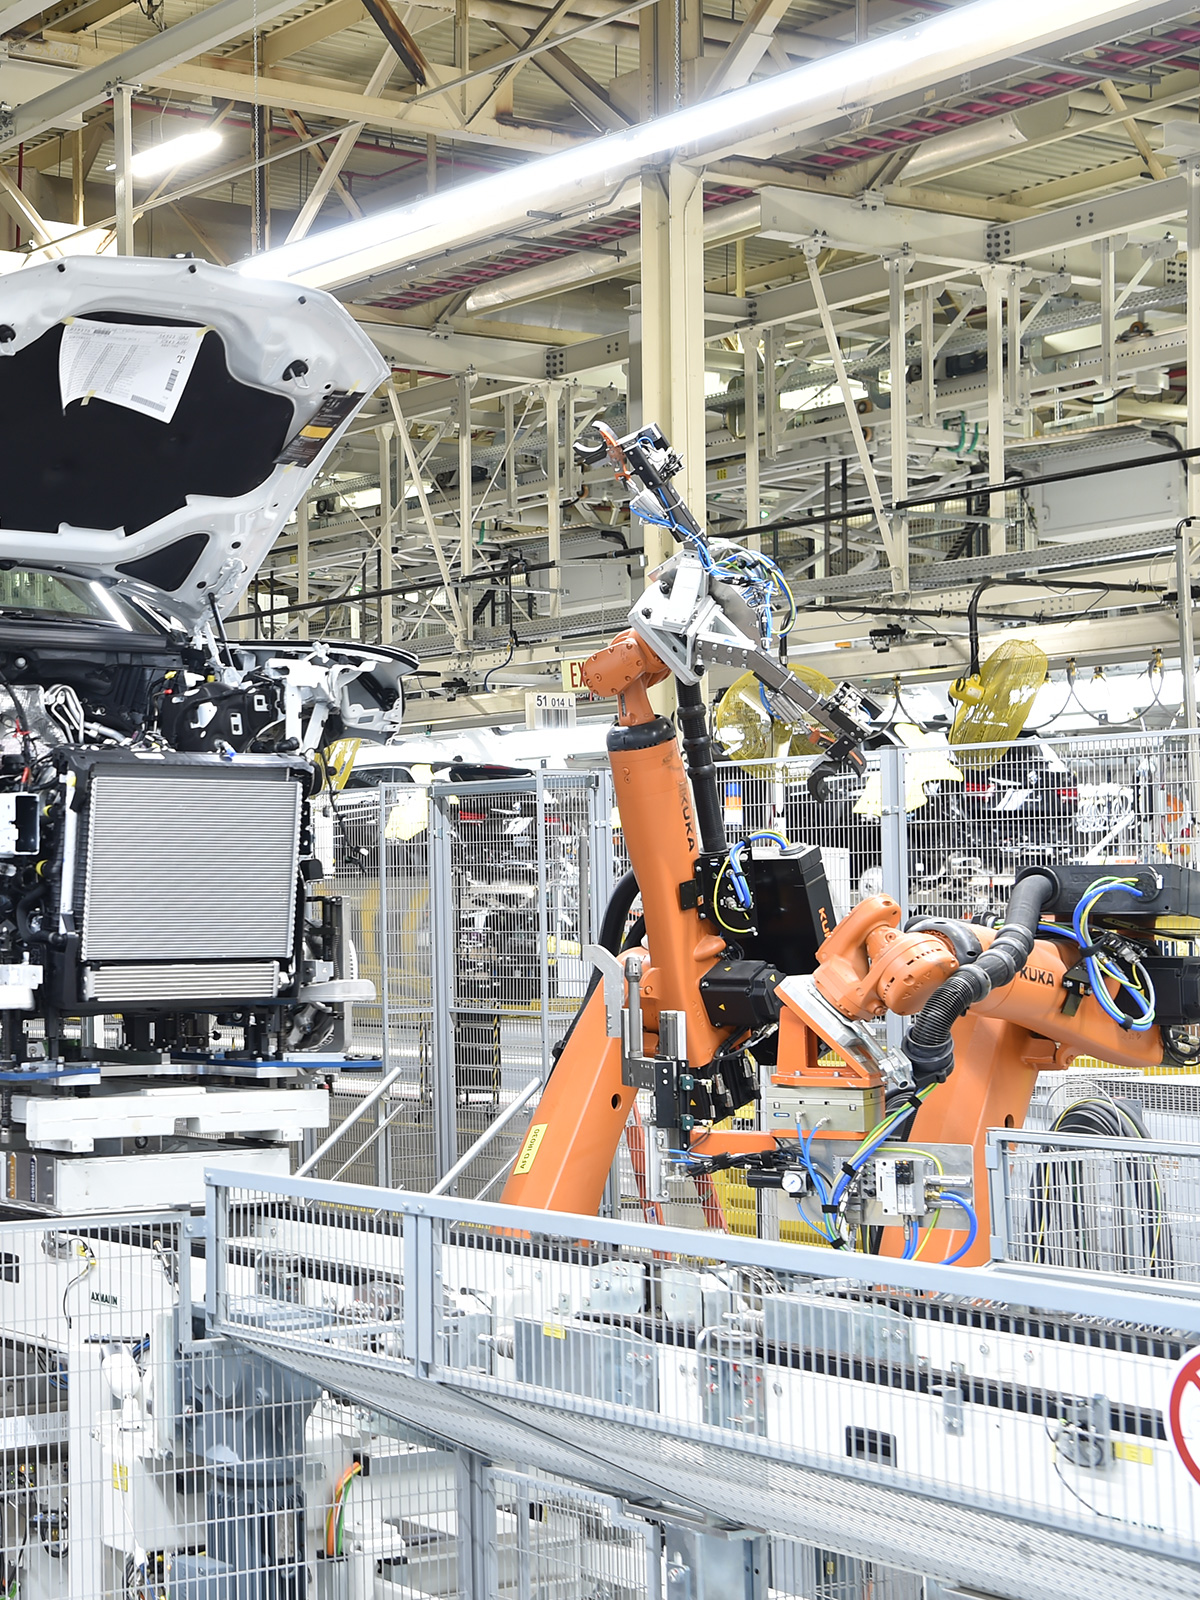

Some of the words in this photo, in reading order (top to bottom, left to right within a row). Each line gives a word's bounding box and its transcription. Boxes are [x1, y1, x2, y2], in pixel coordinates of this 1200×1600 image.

[570, 661, 587, 688] EX
[536, 695, 548, 707] 51
[551, 697, 565, 707] 014
[568, 698, 574, 708] L
[680, 796, 695, 852] KUKA
[818, 907, 832, 938] KU
[1019, 965, 1055, 987] KUKA
